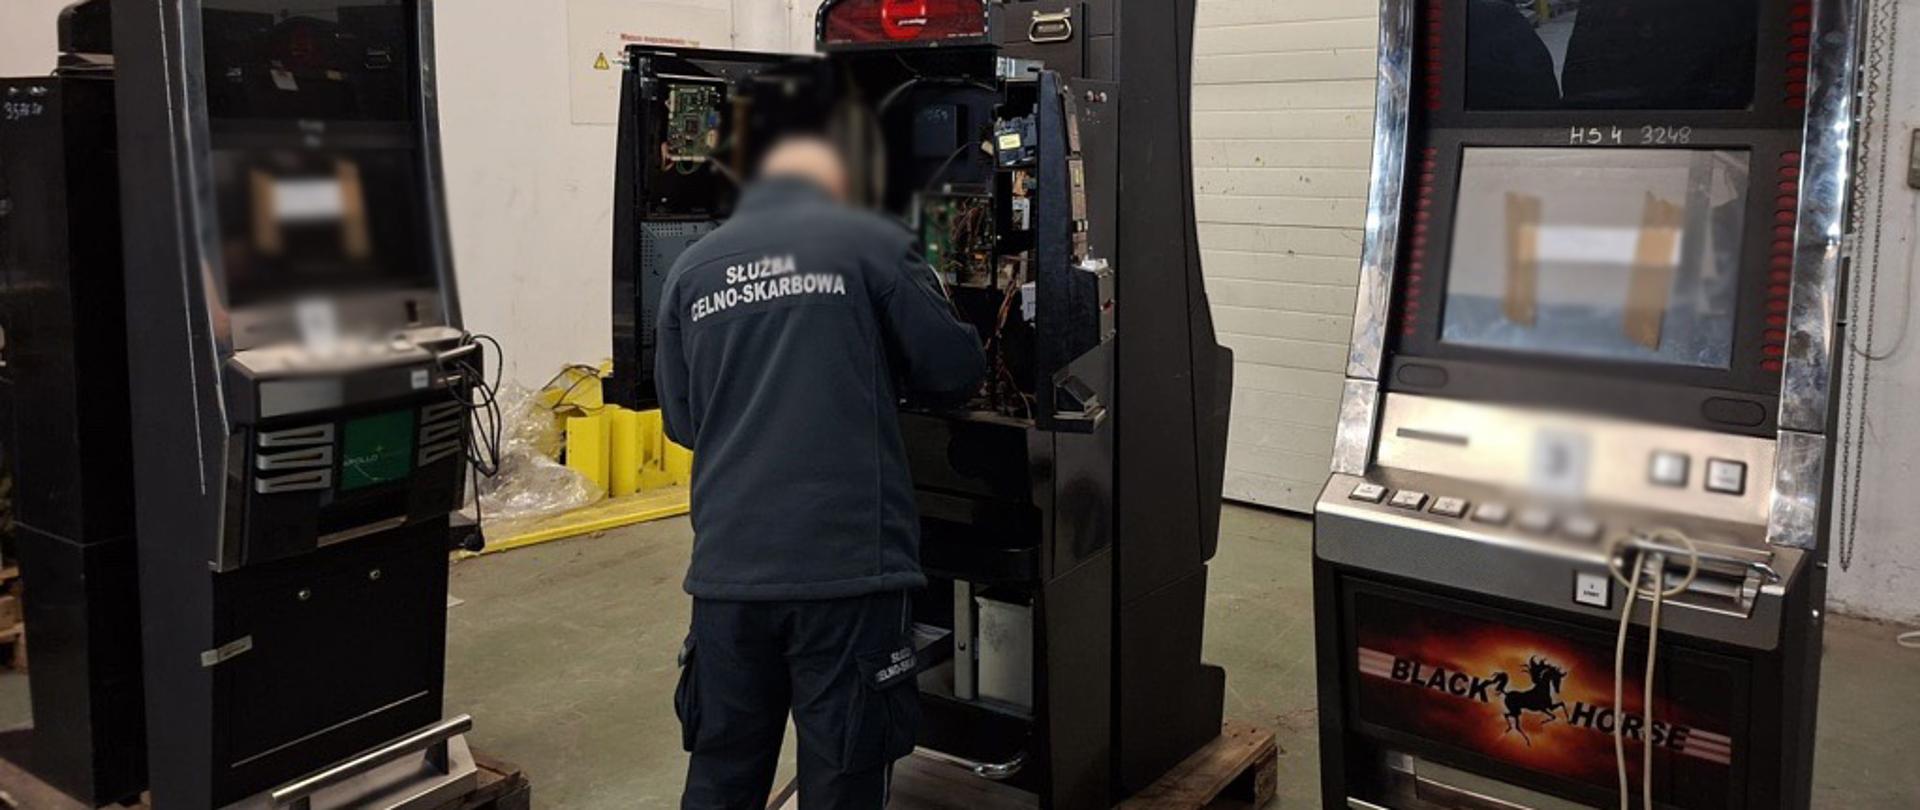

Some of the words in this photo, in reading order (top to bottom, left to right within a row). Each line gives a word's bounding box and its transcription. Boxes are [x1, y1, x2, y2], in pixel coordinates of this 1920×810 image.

[1641, 125, 1691, 145] 3248
[726, 254, 796, 285] SŁUŻBA
[691, 274, 846, 322] CELNO-SKARBOWA
[1391, 657, 1491, 703] BLACK
[1569, 701, 1691, 749] HORSE
